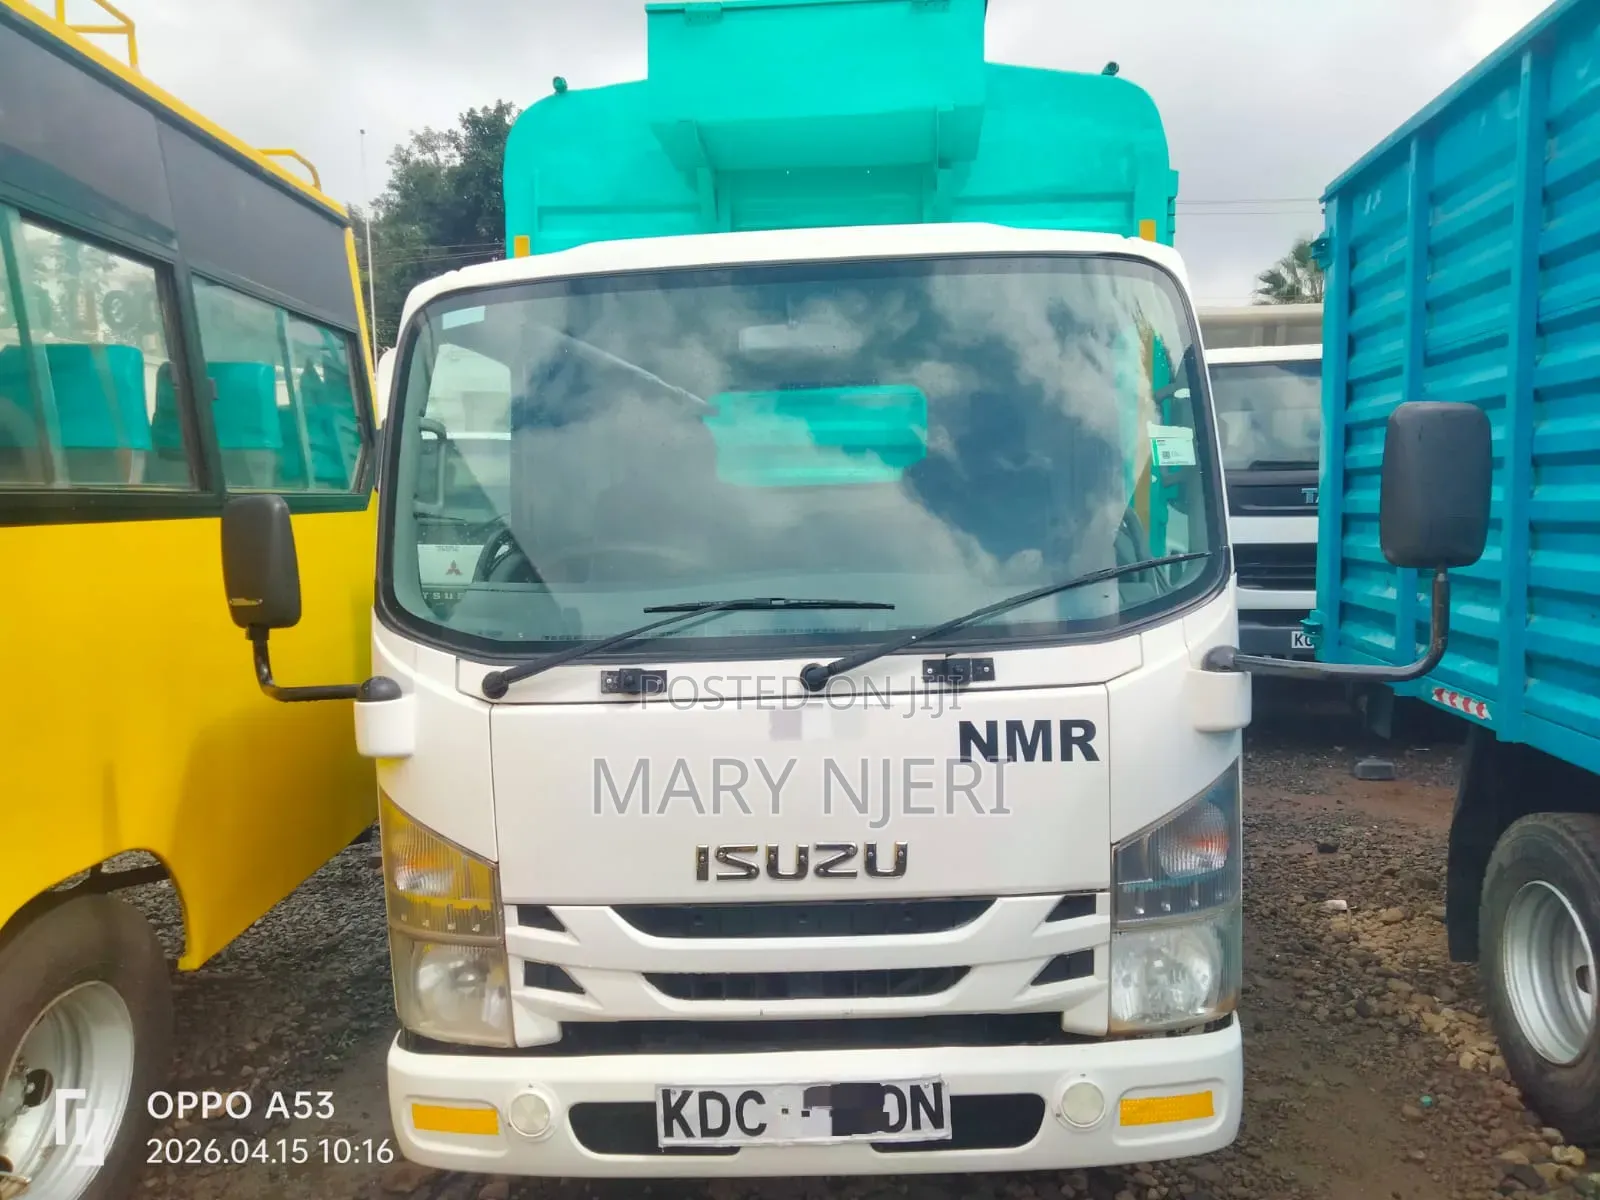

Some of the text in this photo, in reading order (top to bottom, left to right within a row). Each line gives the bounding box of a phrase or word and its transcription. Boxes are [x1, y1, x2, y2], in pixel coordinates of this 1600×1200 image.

[1301, 488, 1319, 503] T
[959, 720, 1100, 762] NMR
[696, 841, 908, 881] ISUZU
[661, 1089, 767, 1138] KDC
